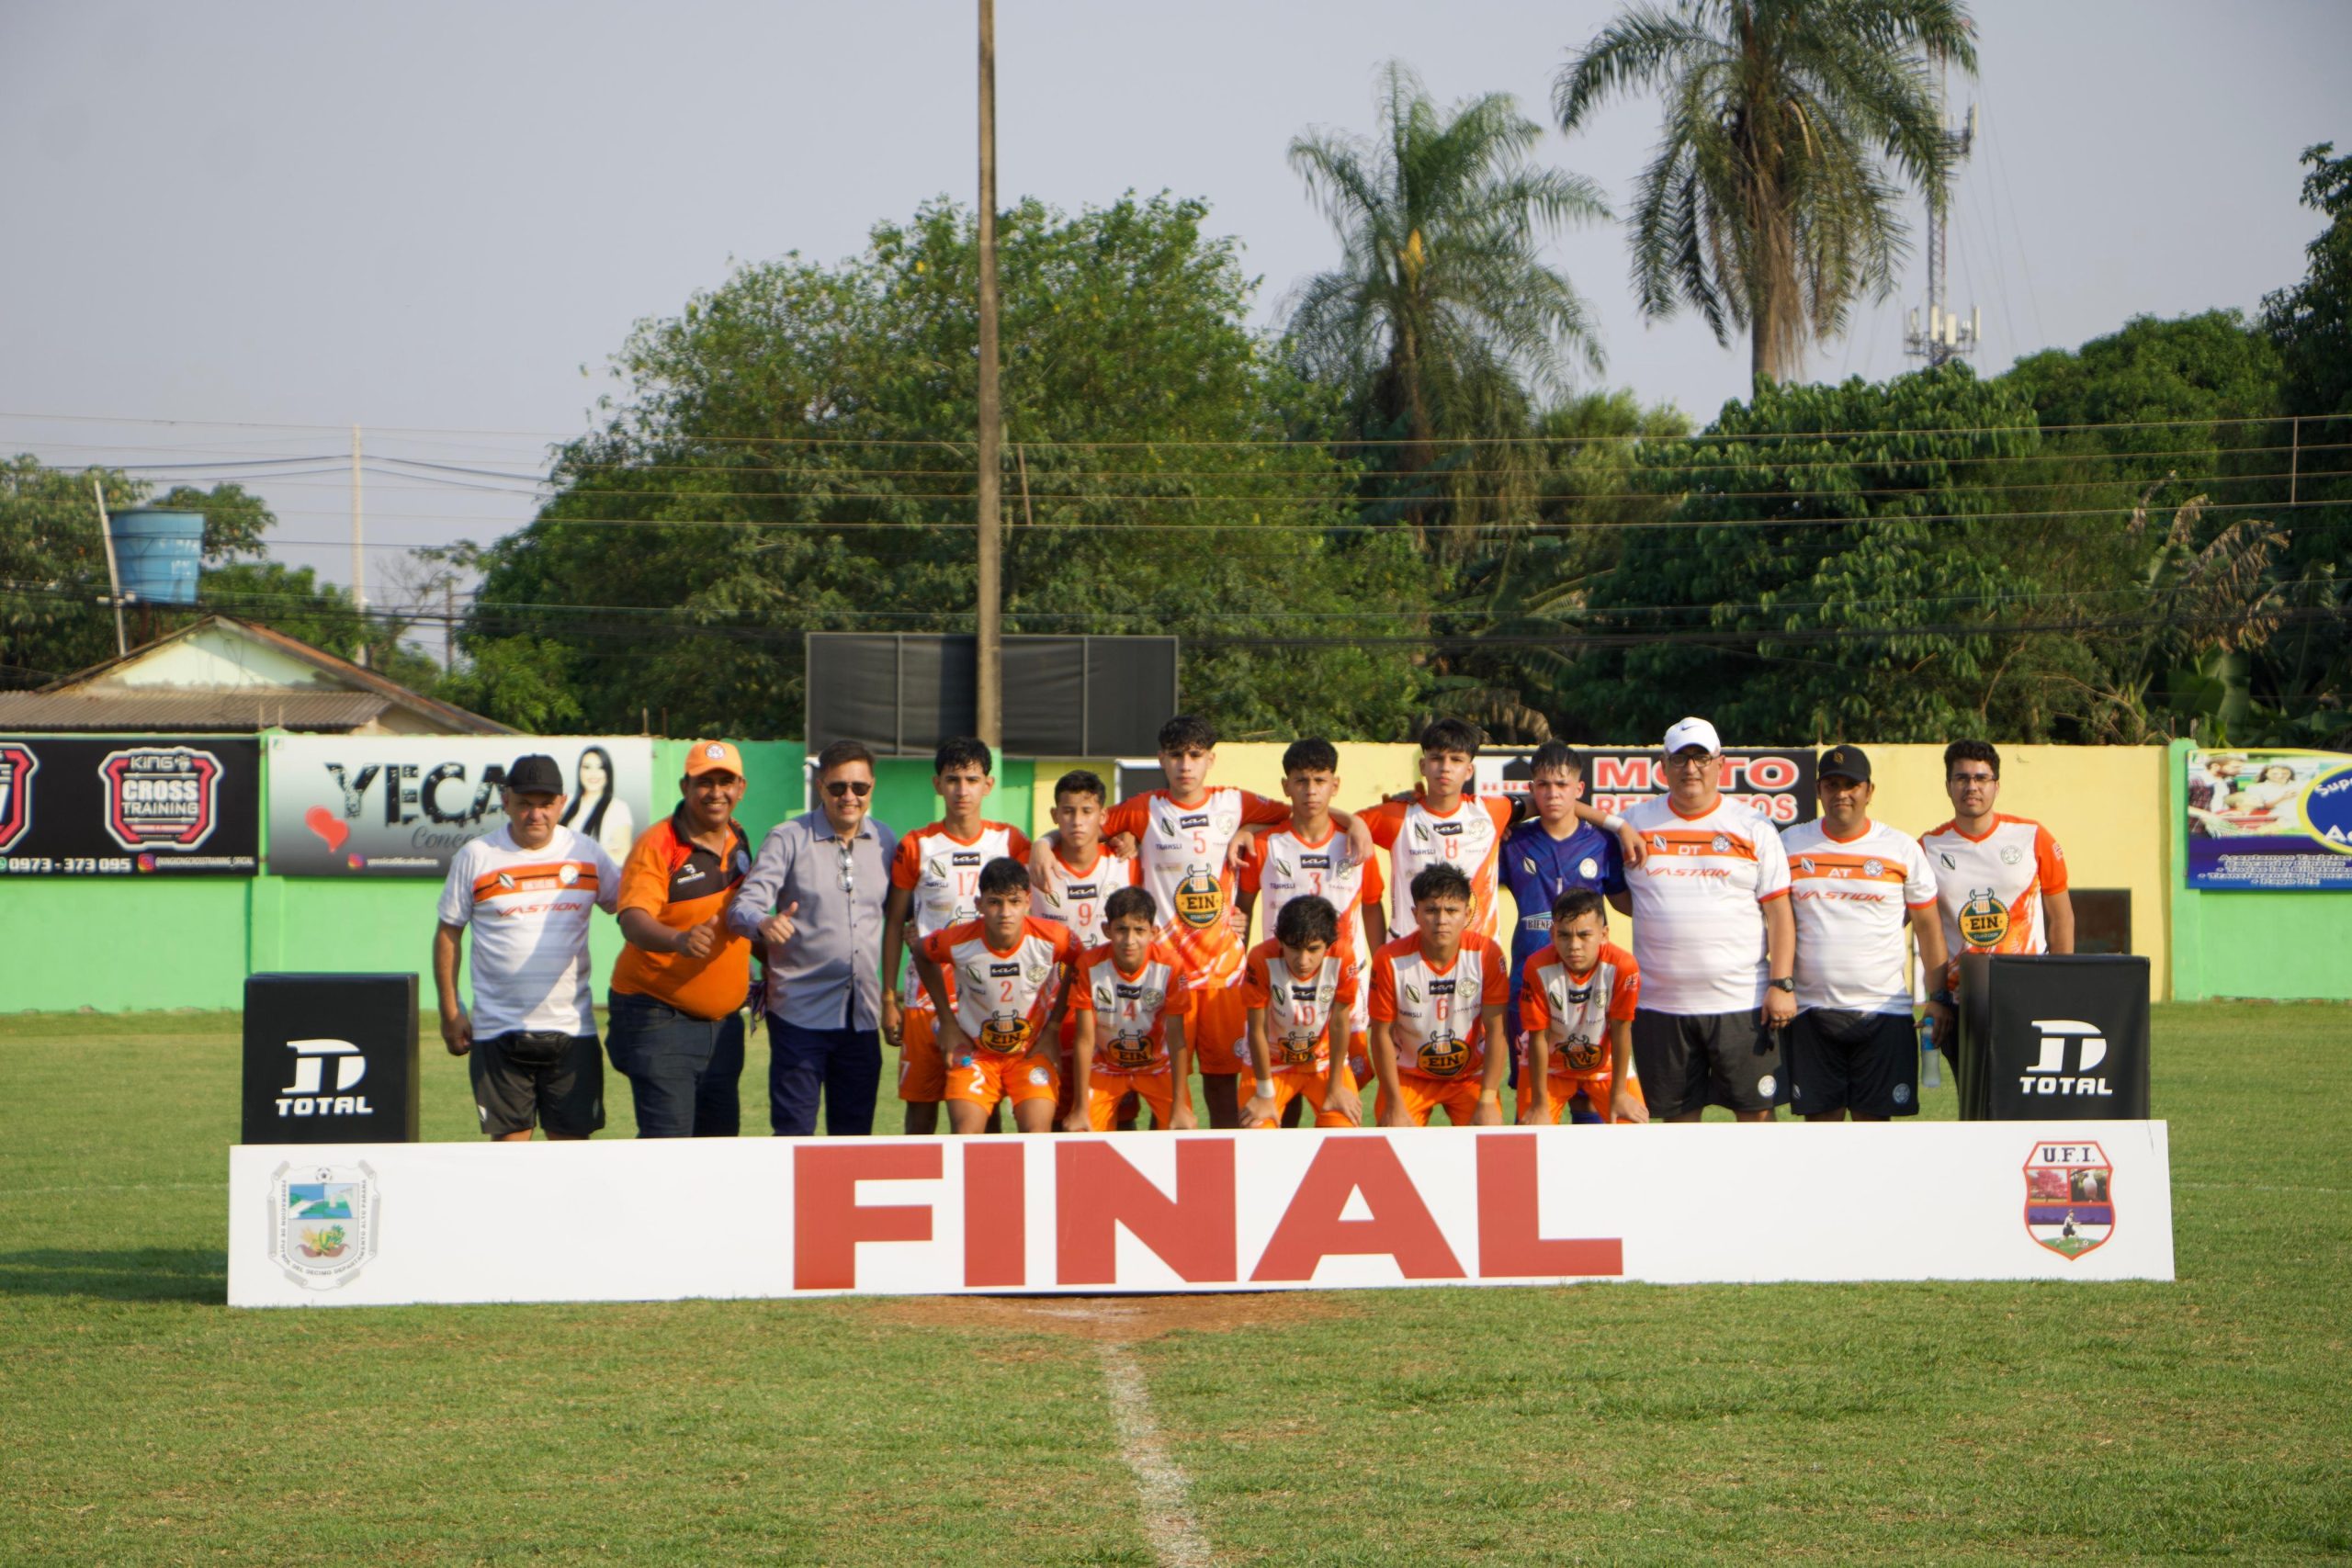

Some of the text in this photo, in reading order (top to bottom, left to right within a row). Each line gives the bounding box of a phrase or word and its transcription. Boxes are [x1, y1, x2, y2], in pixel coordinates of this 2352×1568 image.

[122, 780, 199, 802] CROSS
[121, 802, 199, 816] TRAINING
[1193, 830, 1205, 854] 5
[1678, 845, 1702, 855] DT
[9, 858, 52, 873] 0973
[63, 858, 97, 873] 373
[98, 858, 131, 873] 095
[1827, 868, 1852, 878] AT
[957, 872, 979, 897] 17
[1309, 872, 1321, 897] 3
[1187, 895, 1215, 909] EIN
[1078, 902, 1092, 926] 9
[1970, 915, 1998, 930] EIN
[1000, 980, 1014, 1003] 2
[1123, 1000, 1137, 1021] 4
[1293, 1005, 1316, 1026] 10
[1436, 998, 1449, 1021] 6
[990, 1032, 1021, 1044] EIN
[1430, 1054, 1460, 1066] EIN
[2019, 1077, 2113, 1095] TOTAL
[276, 1096, 374, 1117] TOTAL
[2042, 1147, 2096, 1163] U.F.I.
[793, 1133, 1623, 1290] FINAL
